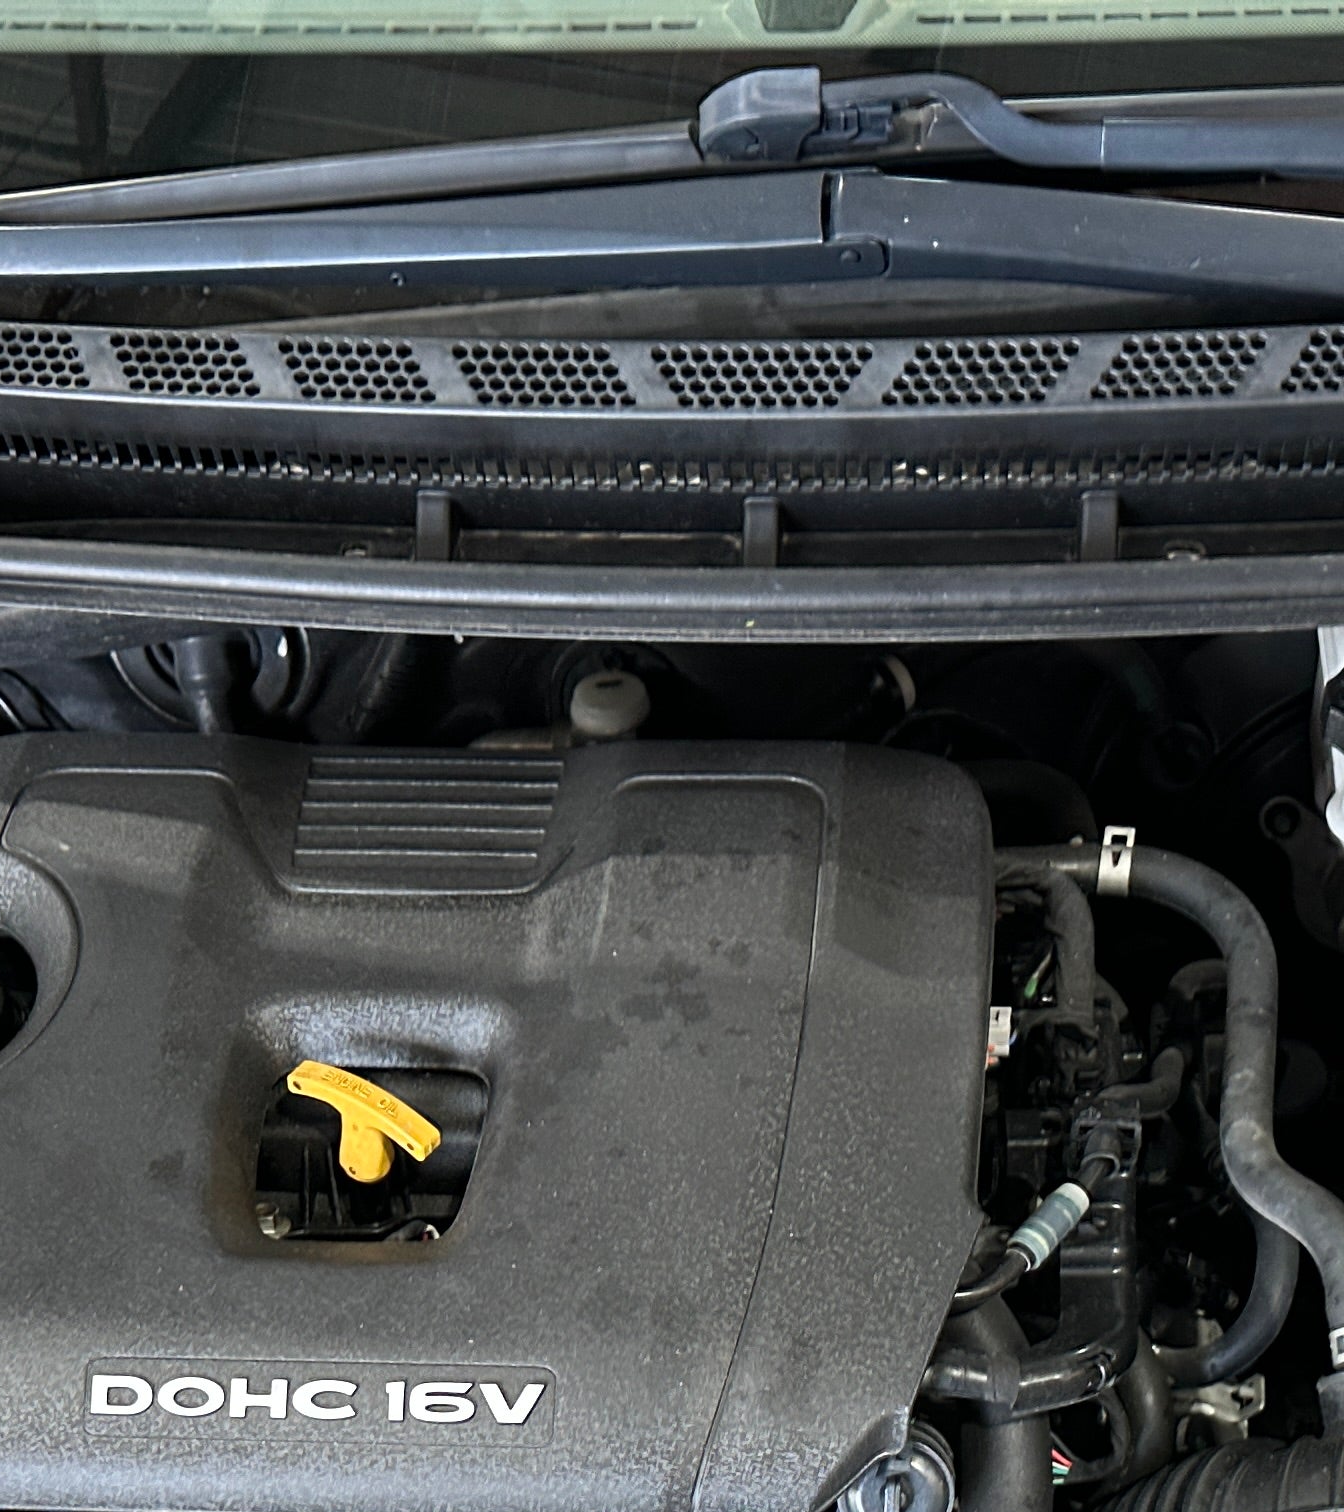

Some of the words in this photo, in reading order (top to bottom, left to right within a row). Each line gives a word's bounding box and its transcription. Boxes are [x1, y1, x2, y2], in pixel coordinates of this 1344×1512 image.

[378, 1099, 399, 1118] OIL
[90, 1374, 358, 1420] DOHC
[385, 1380, 546, 1425] 16V
